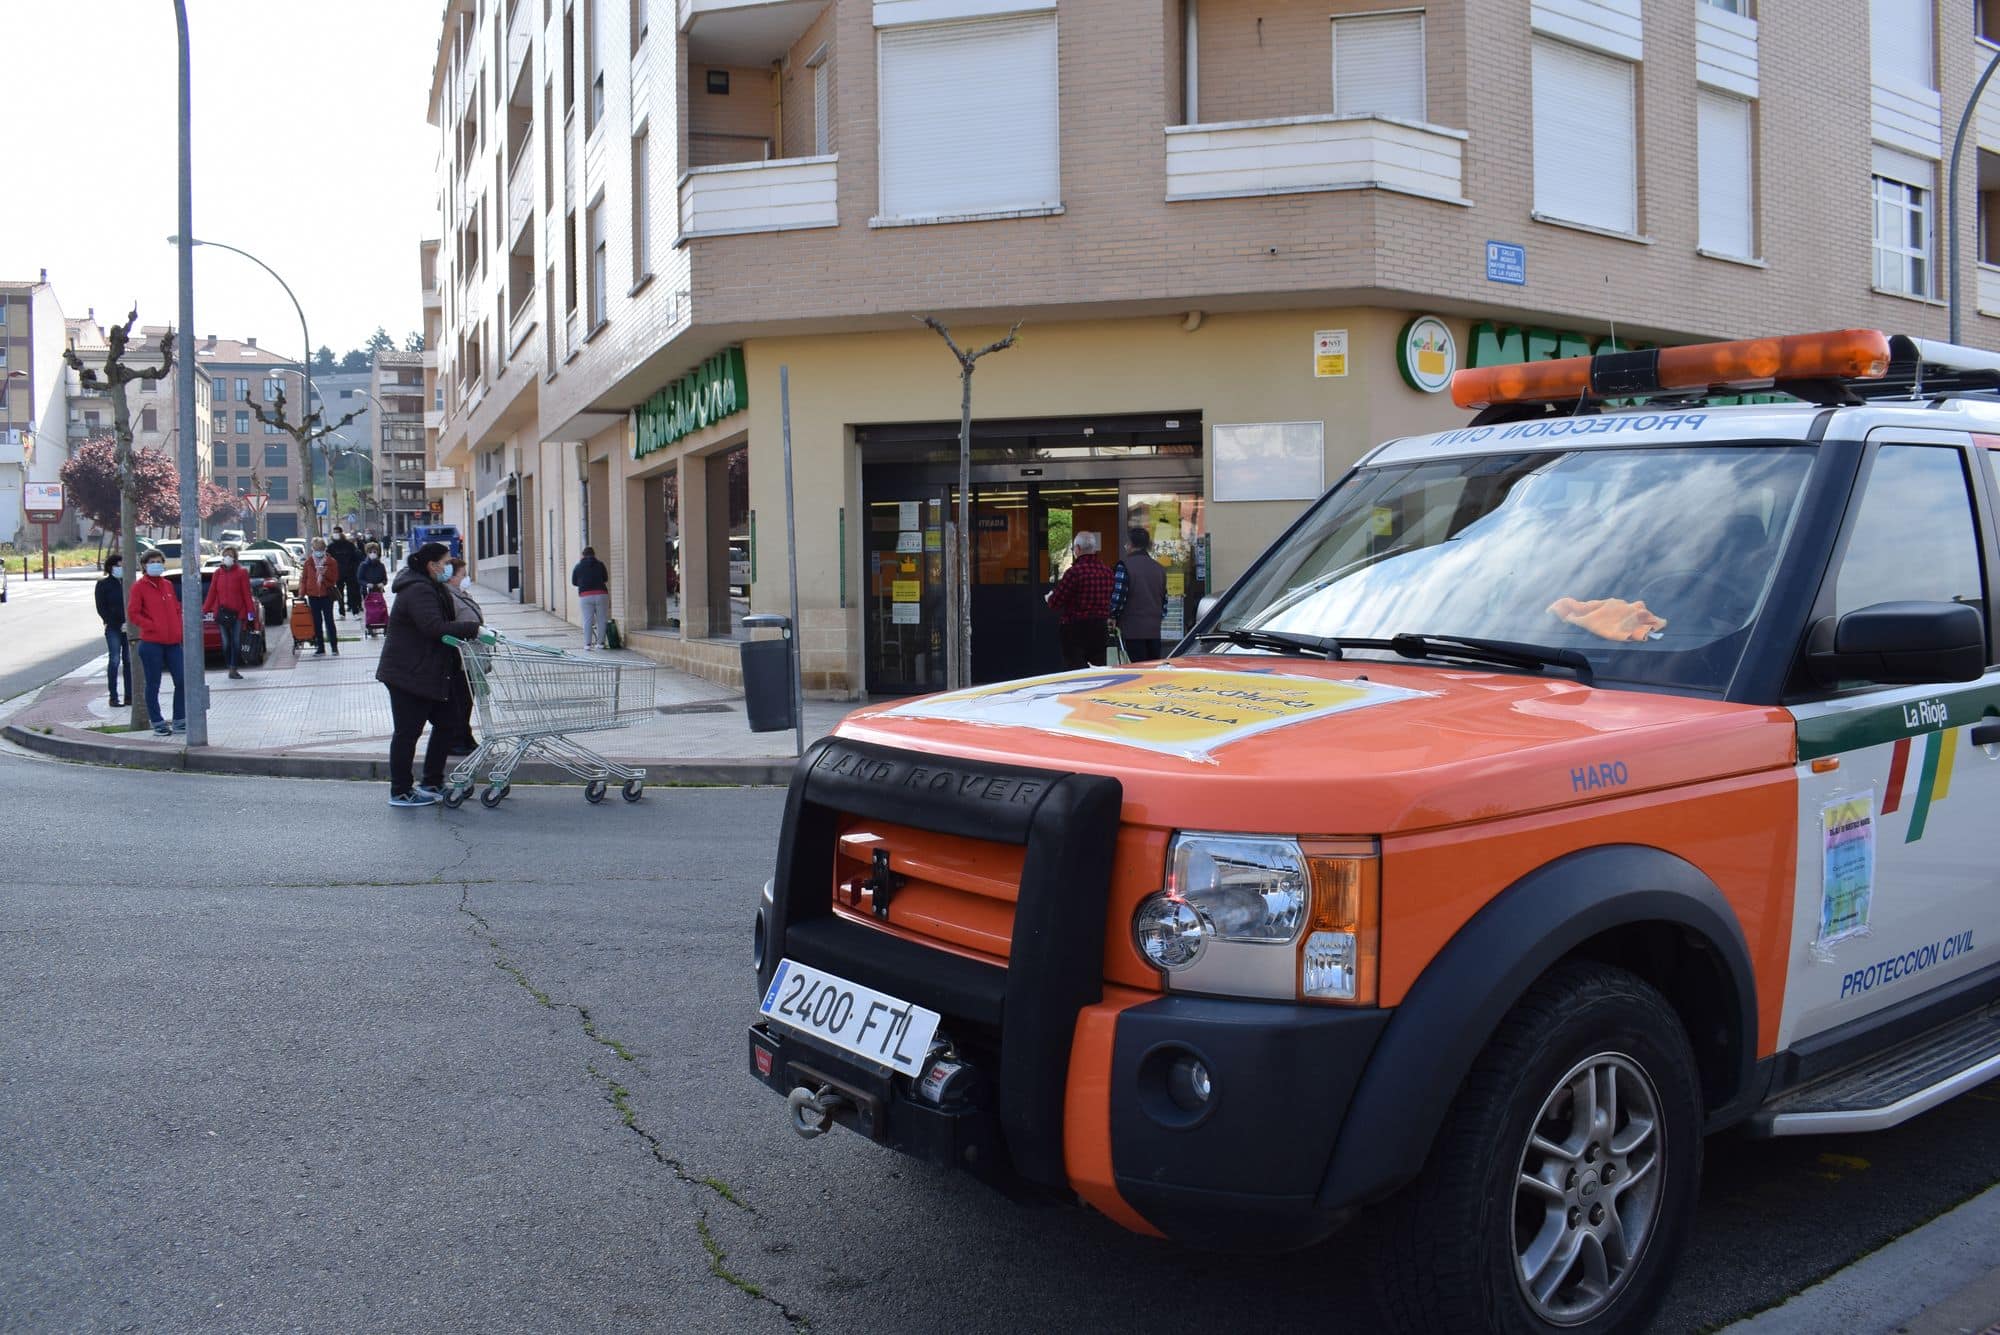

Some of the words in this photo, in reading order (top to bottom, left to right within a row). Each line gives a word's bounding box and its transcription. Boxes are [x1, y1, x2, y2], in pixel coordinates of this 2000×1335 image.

[639, 347, 737, 457] MERCADONA
[1902, 704, 1920, 728] La
[1919, 699, 1948, 728] Rioja
[815, 750, 896, 782] LAND
[903, 767, 1041, 803] ROVER
[1570, 760, 1628, 792] HARO
[1840, 941, 1940, 999] PROTECCION
[1943, 929, 1974, 961] CIVIL
[779, 973, 854, 1034] 2400
[856, 1001, 913, 1066] FTL
